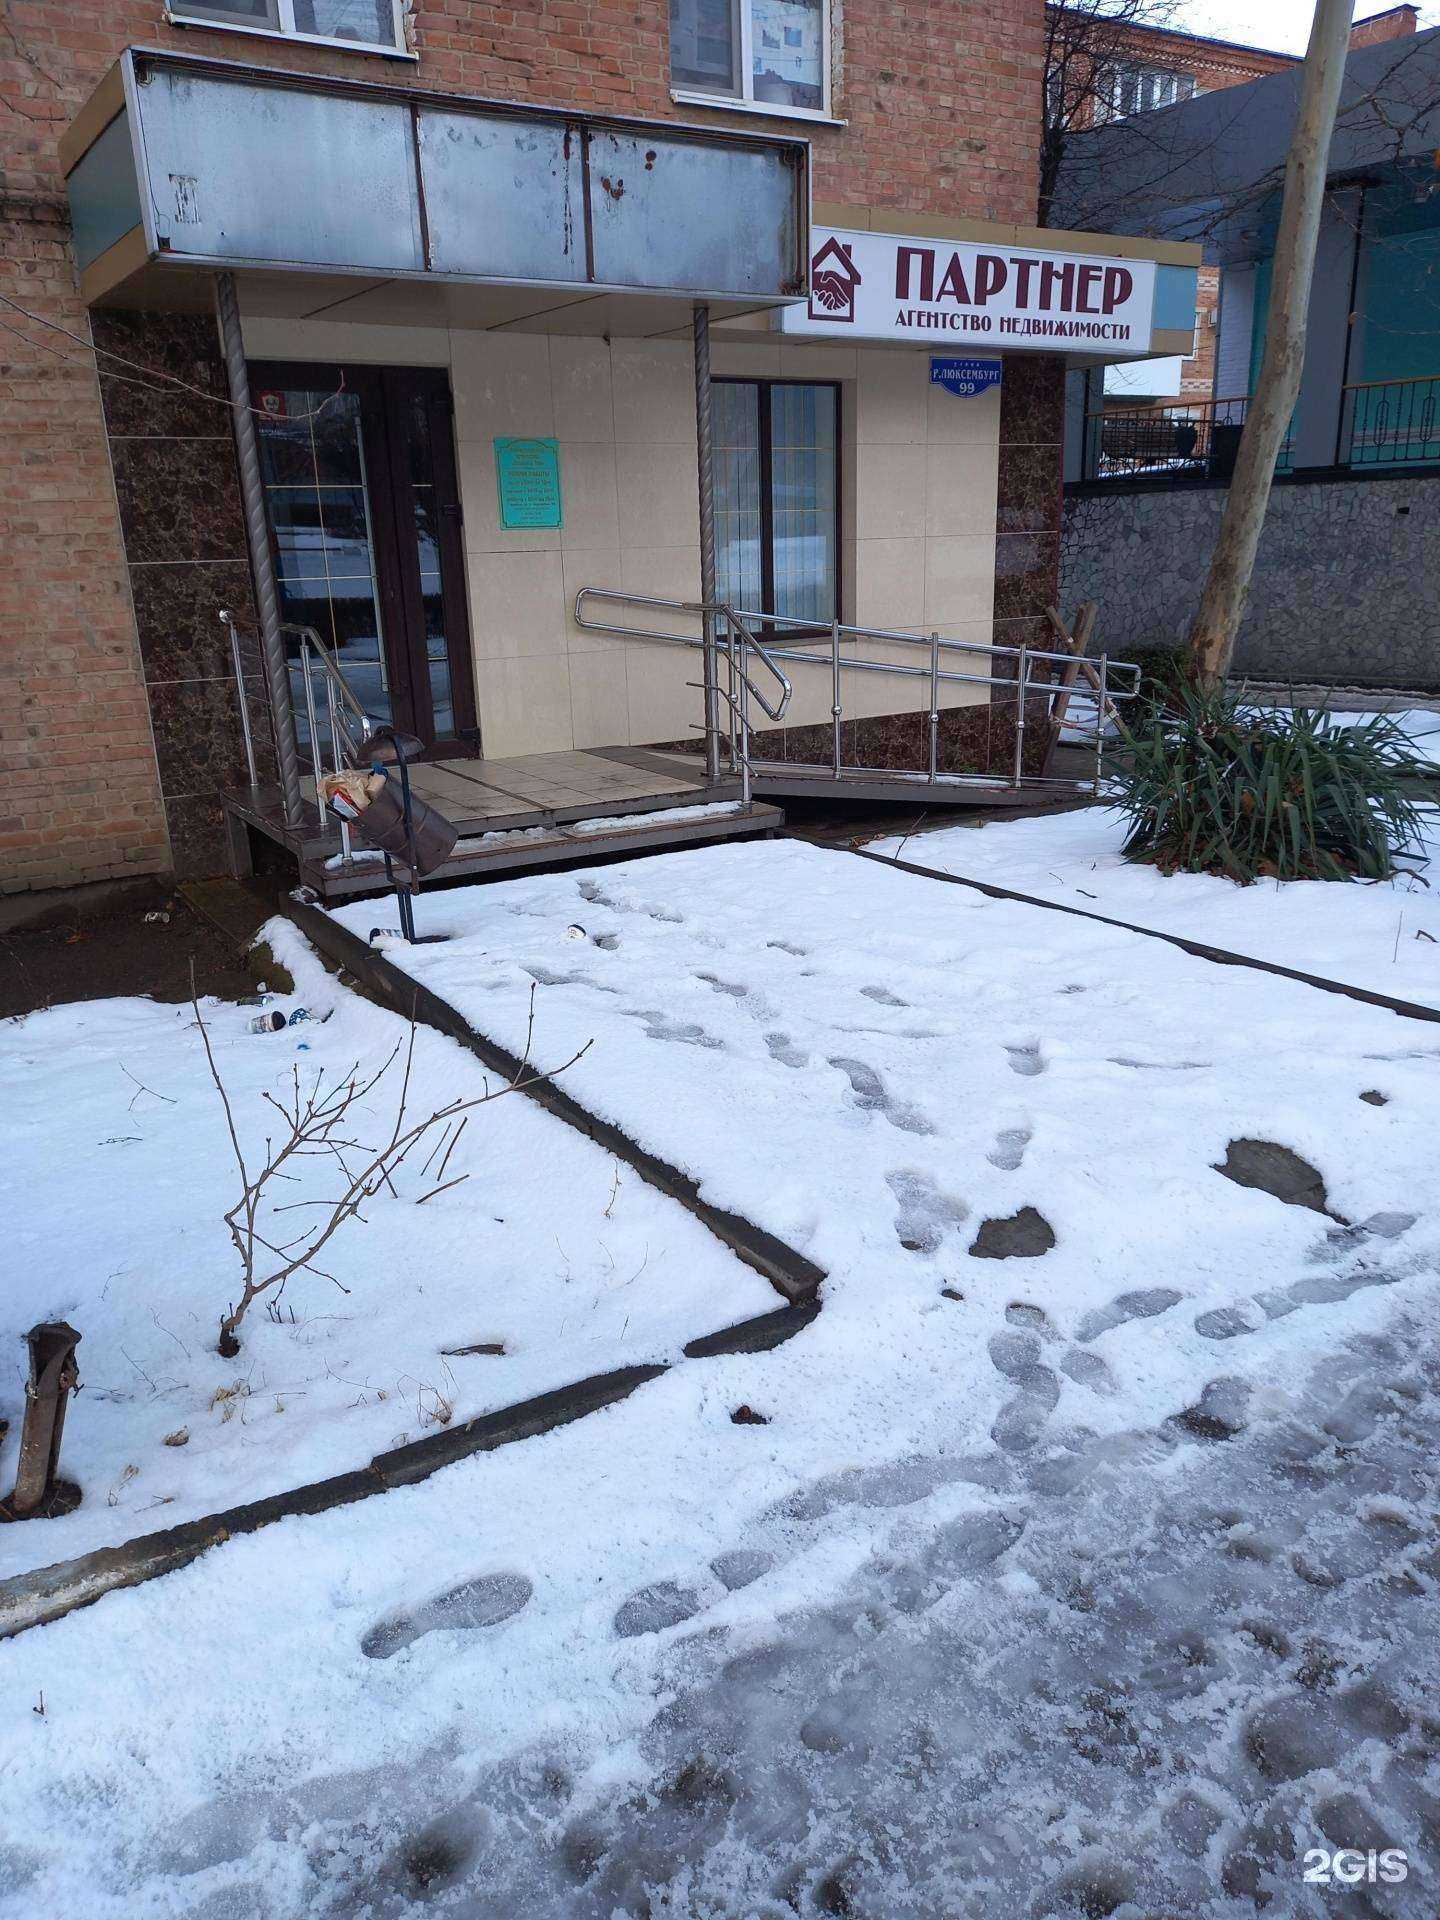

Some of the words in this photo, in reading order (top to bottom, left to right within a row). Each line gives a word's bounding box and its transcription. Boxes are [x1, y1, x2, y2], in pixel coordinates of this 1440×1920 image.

[895, 246, 1133, 314] ПАРТНЕР
[895, 309, 992, 332] АГЕНТСТВО
[1000, 316, 1130, 340] НЕДВИЖИМОСТИ
[959, 382, 975, 394] 99
